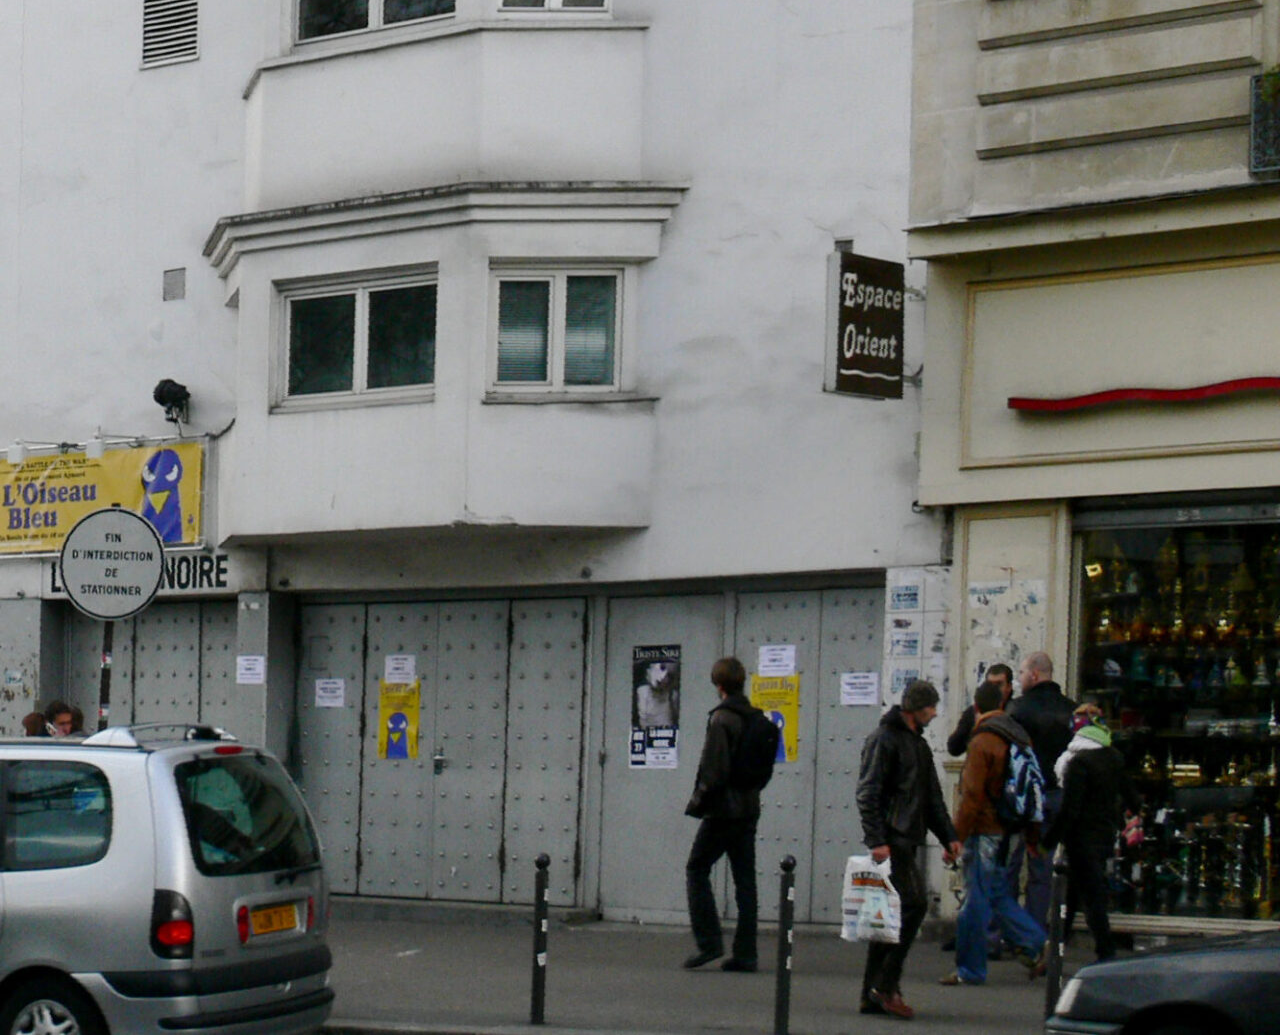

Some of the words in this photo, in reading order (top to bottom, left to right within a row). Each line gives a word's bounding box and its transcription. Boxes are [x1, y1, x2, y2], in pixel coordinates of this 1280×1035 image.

[842, 272, 902, 311] Espace
[843, 324, 897, 359] Orient
[2, 481, 96, 507] L'Oiseau
[8, 507, 58, 530] Bleu
[105, 533, 122, 543] FIN
[72, 550, 153, 562] D'INTERDICTION
[105, 568, 118, 578] DE
[160, 555, 228, 590] NOIRE
[80, 585, 142, 596] STATIONNER
